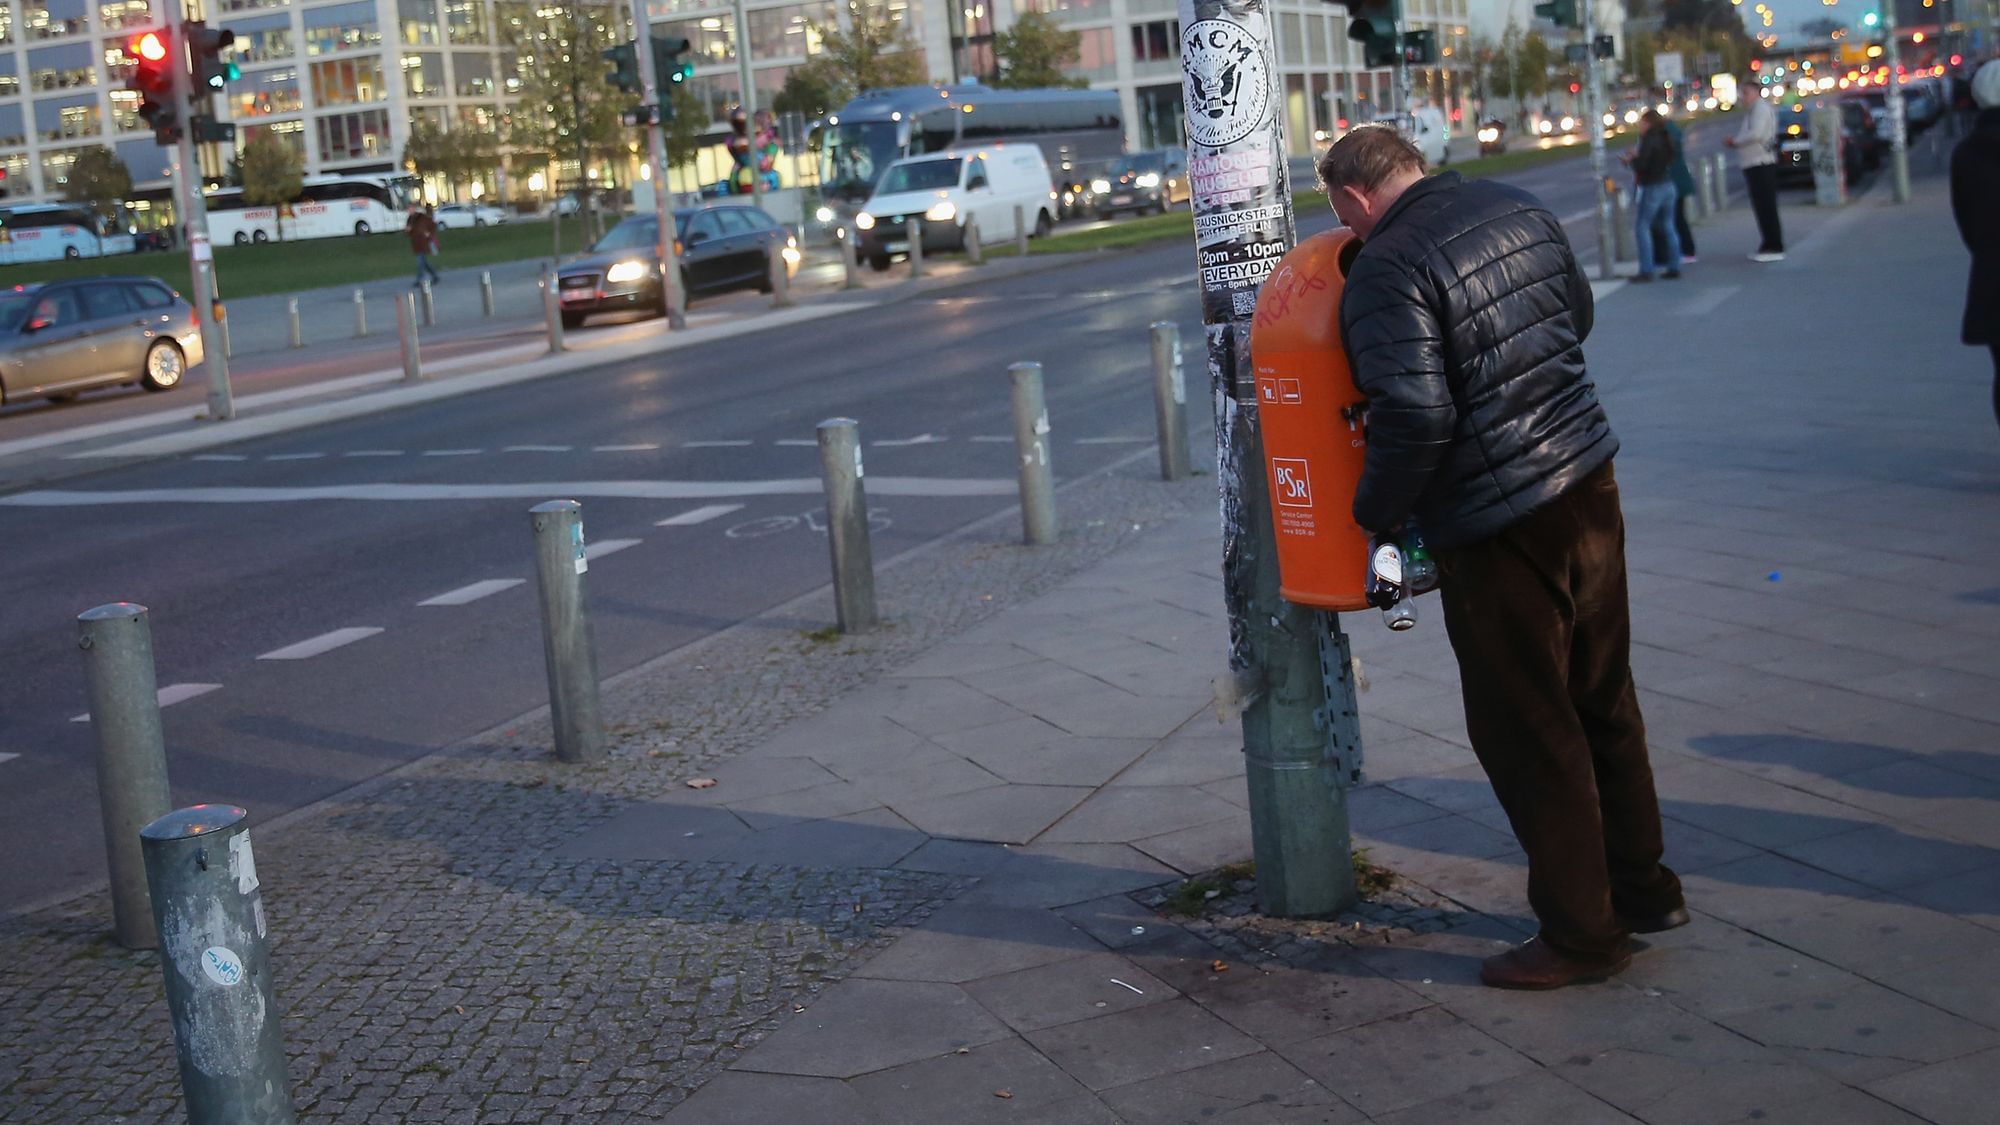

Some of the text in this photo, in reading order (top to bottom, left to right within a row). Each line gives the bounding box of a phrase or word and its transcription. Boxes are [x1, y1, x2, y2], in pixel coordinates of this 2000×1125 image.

[1191, 150, 1270, 177] RAMONE
[1272, 206, 1283, 216] 23
[1229, 220, 1272, 234] BERLIN
[1244, 242, 1285, 258] 10pm
[1249, 274, 1269, 285] WIN
[1276, 467, 1308, 498] BSR
